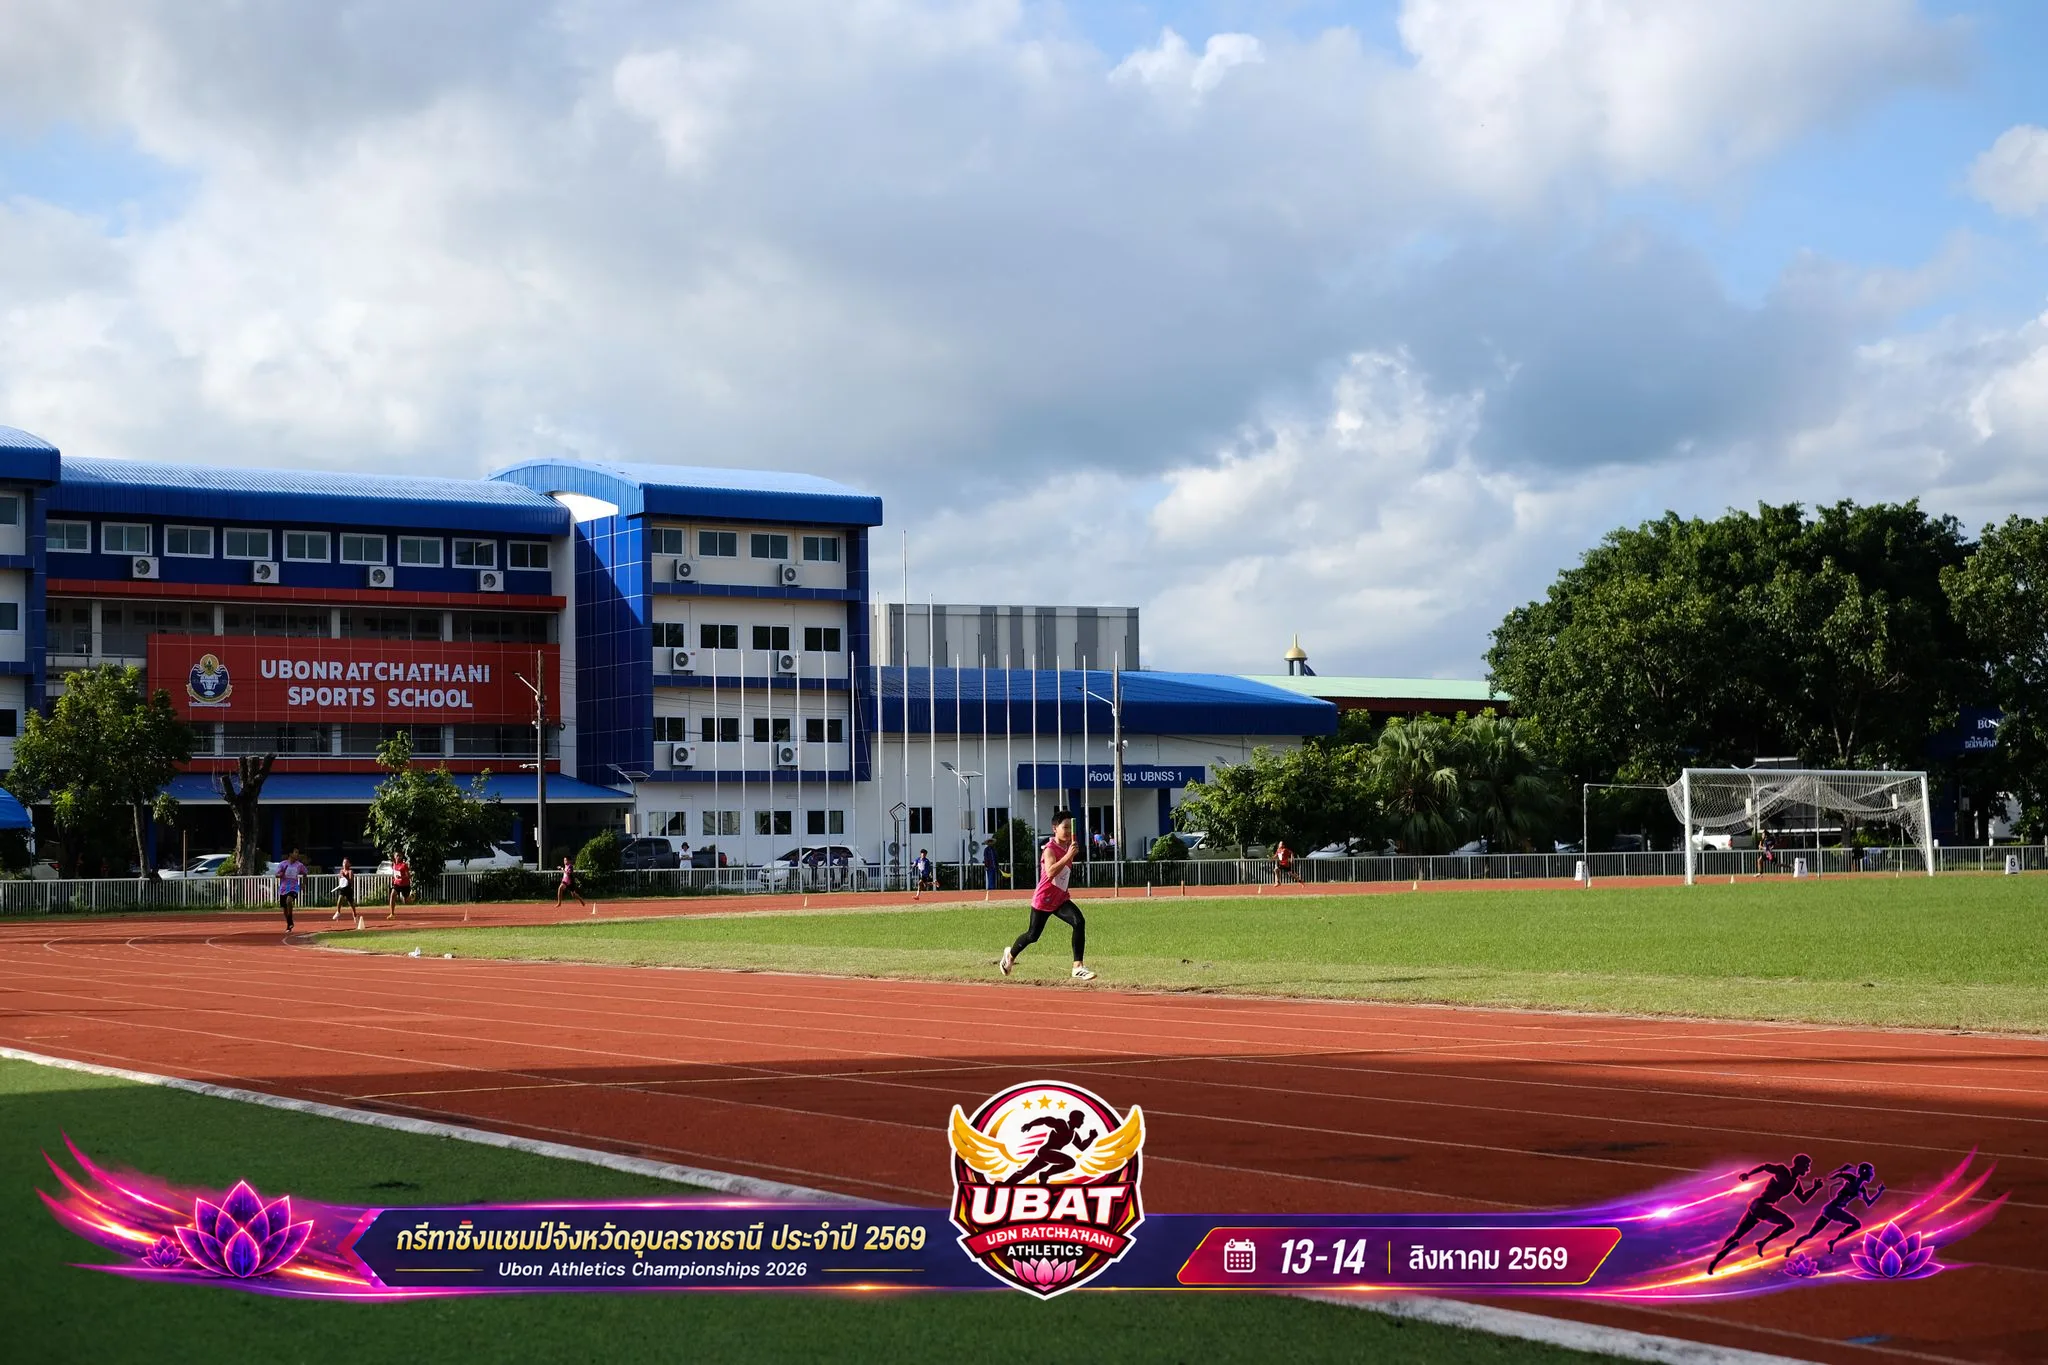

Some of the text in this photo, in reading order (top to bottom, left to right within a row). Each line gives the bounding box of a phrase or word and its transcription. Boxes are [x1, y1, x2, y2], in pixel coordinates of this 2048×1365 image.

[261, 659, 490, 683] UBONRATCHATHANI
[288, 686, 473, 708] SPORTS SCHOOL
[1140, 771, 1175, 782] UBNSS
[1177, 772, 1182, 782] 1
[1799, 860, 1805, 871] 7
[2010, 857, 2016, 868] 6
